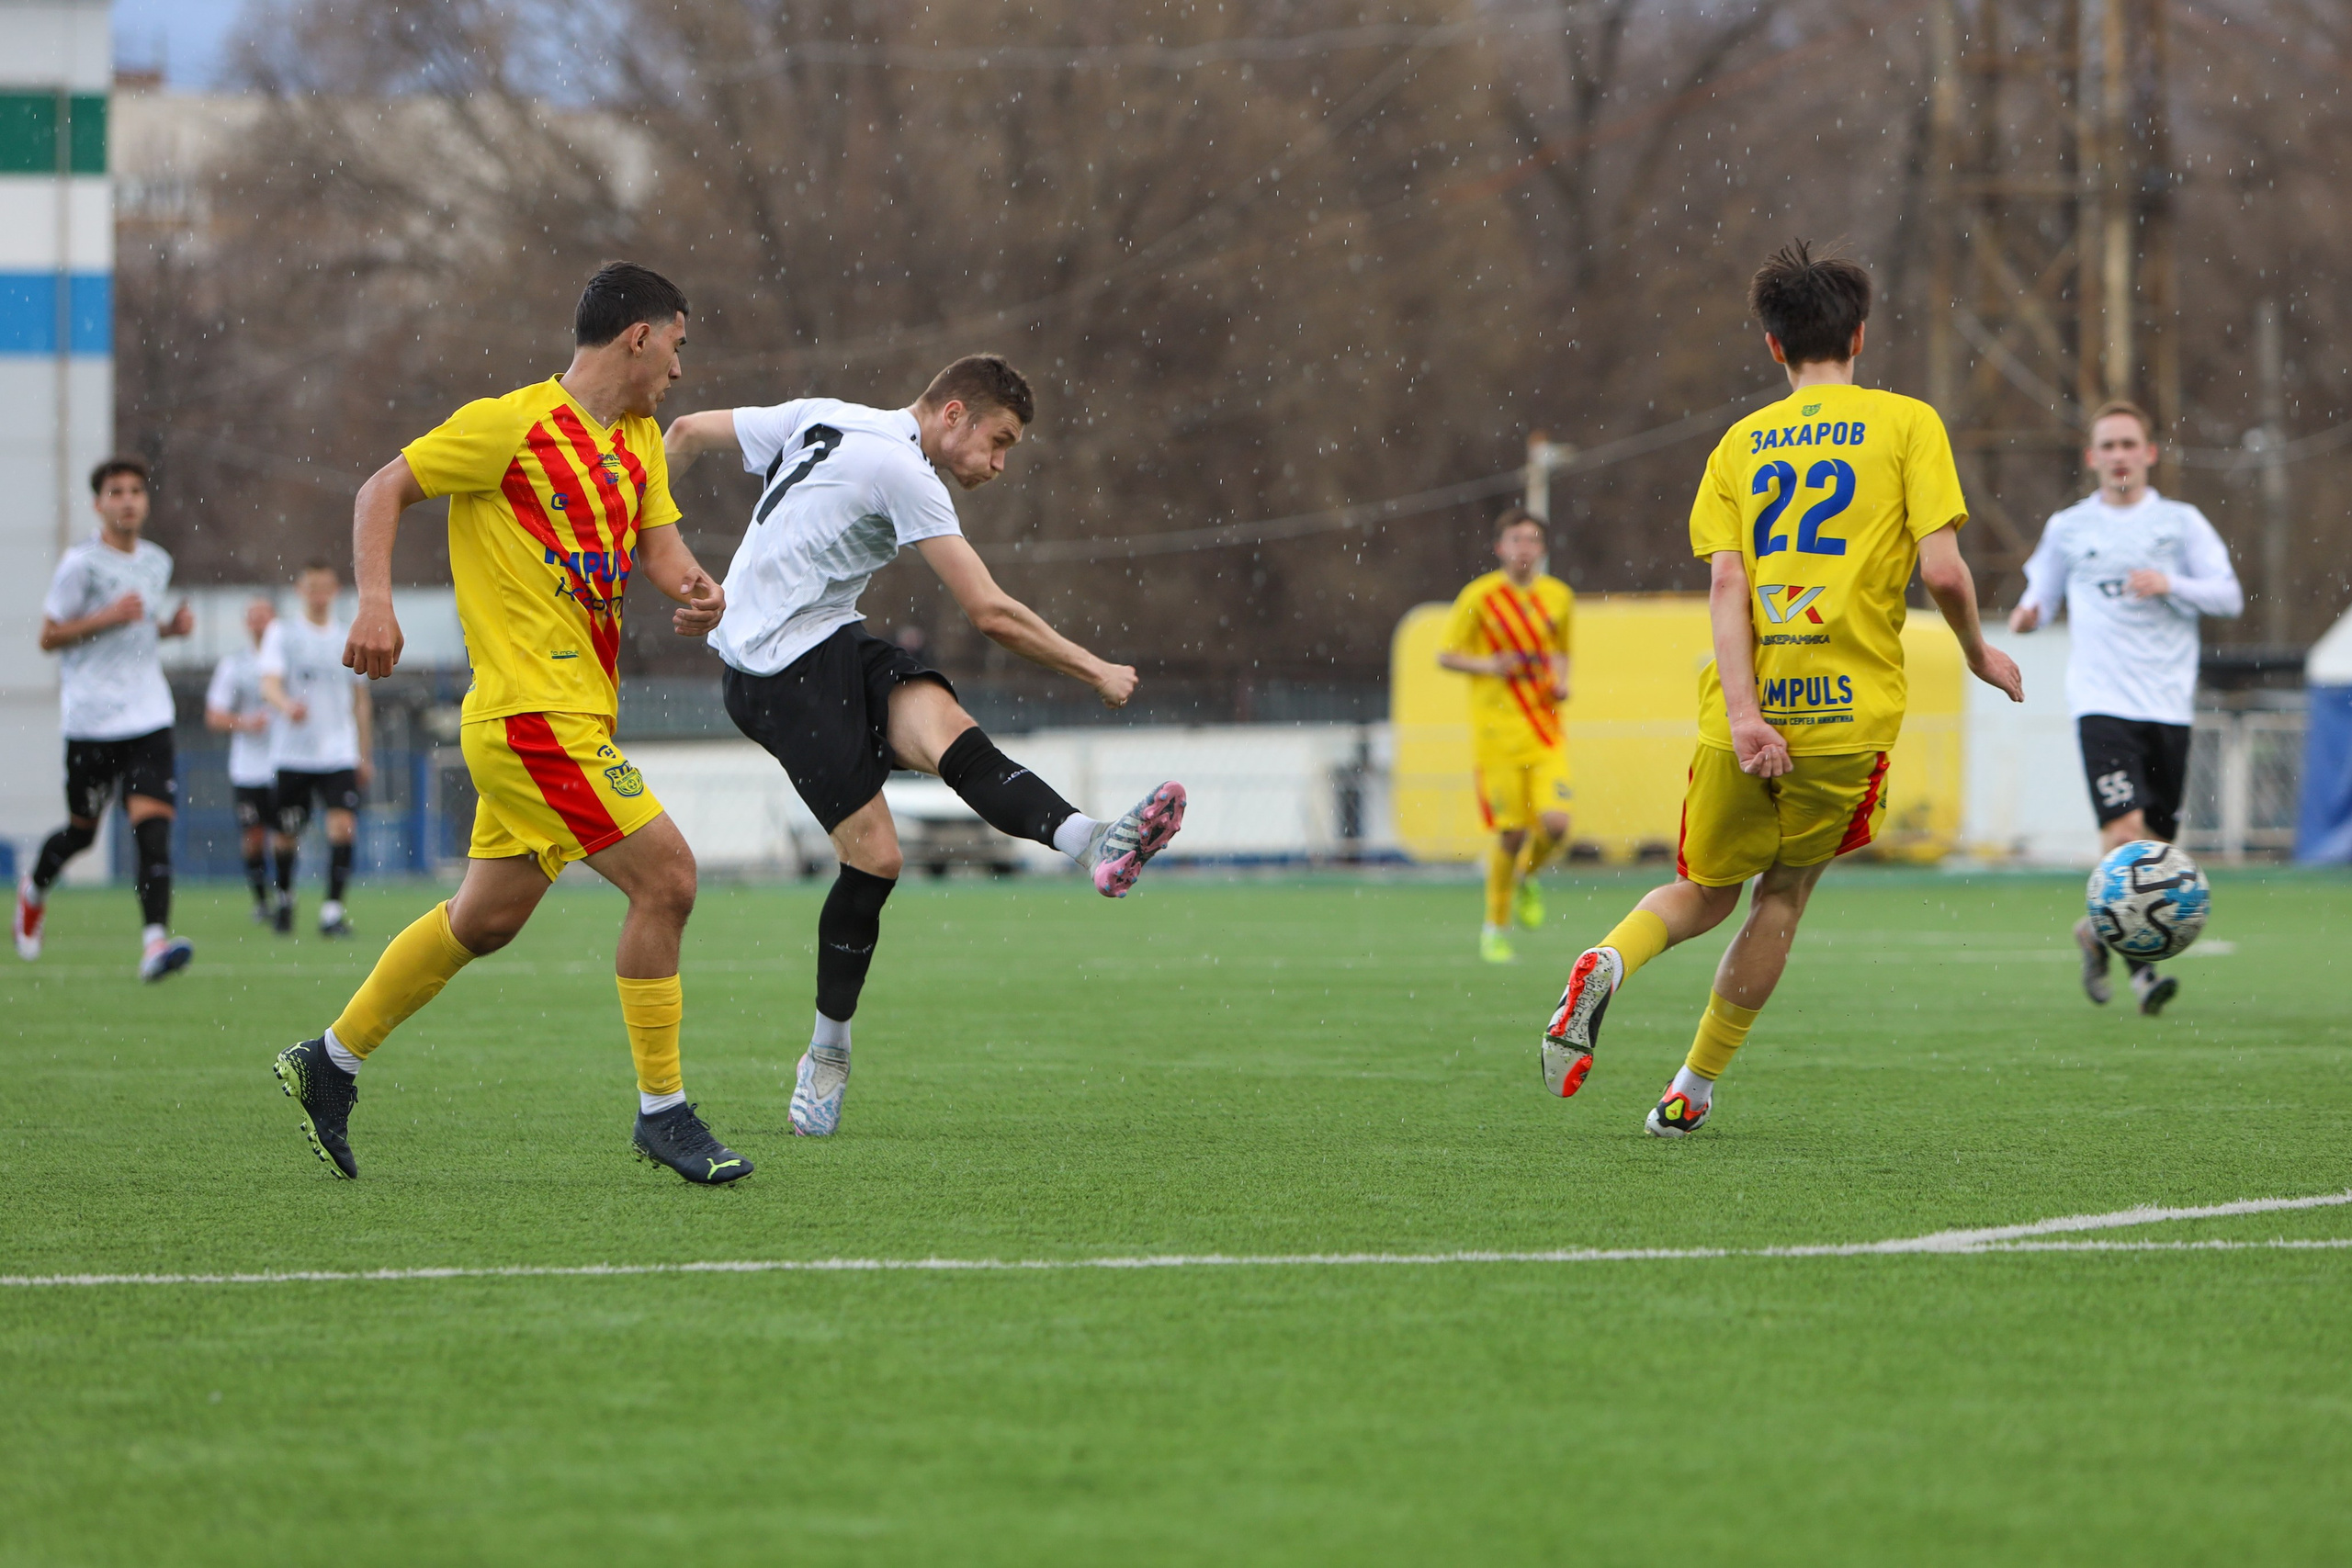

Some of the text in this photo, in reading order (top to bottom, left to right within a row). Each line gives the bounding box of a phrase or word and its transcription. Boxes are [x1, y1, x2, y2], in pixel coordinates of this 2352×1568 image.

[1750, 422, 1866, 455] ЗАХАРОВ
[1752, 458, 1856, 560] 22
[2096, 770, 2134, 808] 55
